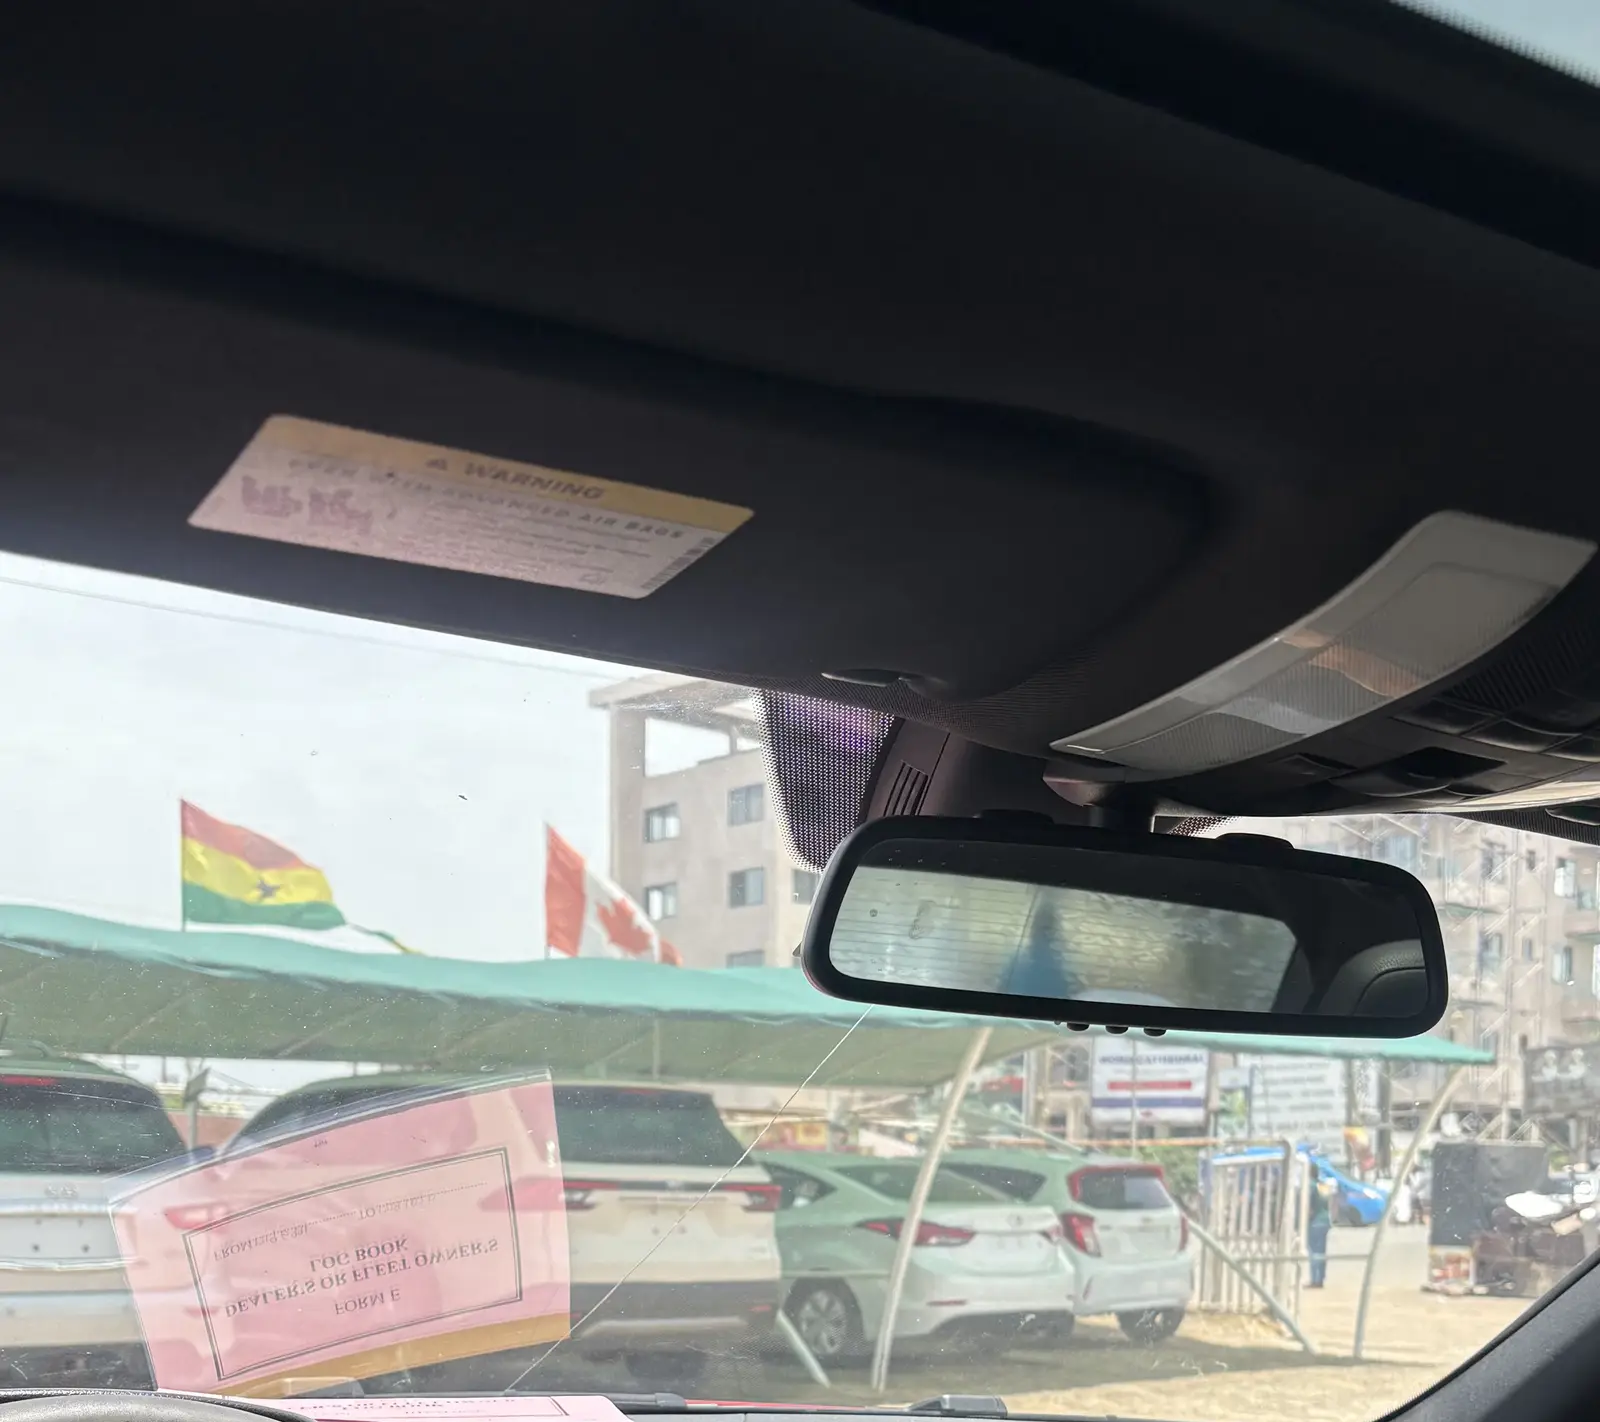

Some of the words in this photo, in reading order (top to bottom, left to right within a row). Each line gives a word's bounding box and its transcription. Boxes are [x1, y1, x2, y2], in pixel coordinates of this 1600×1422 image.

[465, 462, 605, 499] WARNING
[579, 511, 617, 527] AIR
[625, 520, 684, 539] BAGS
